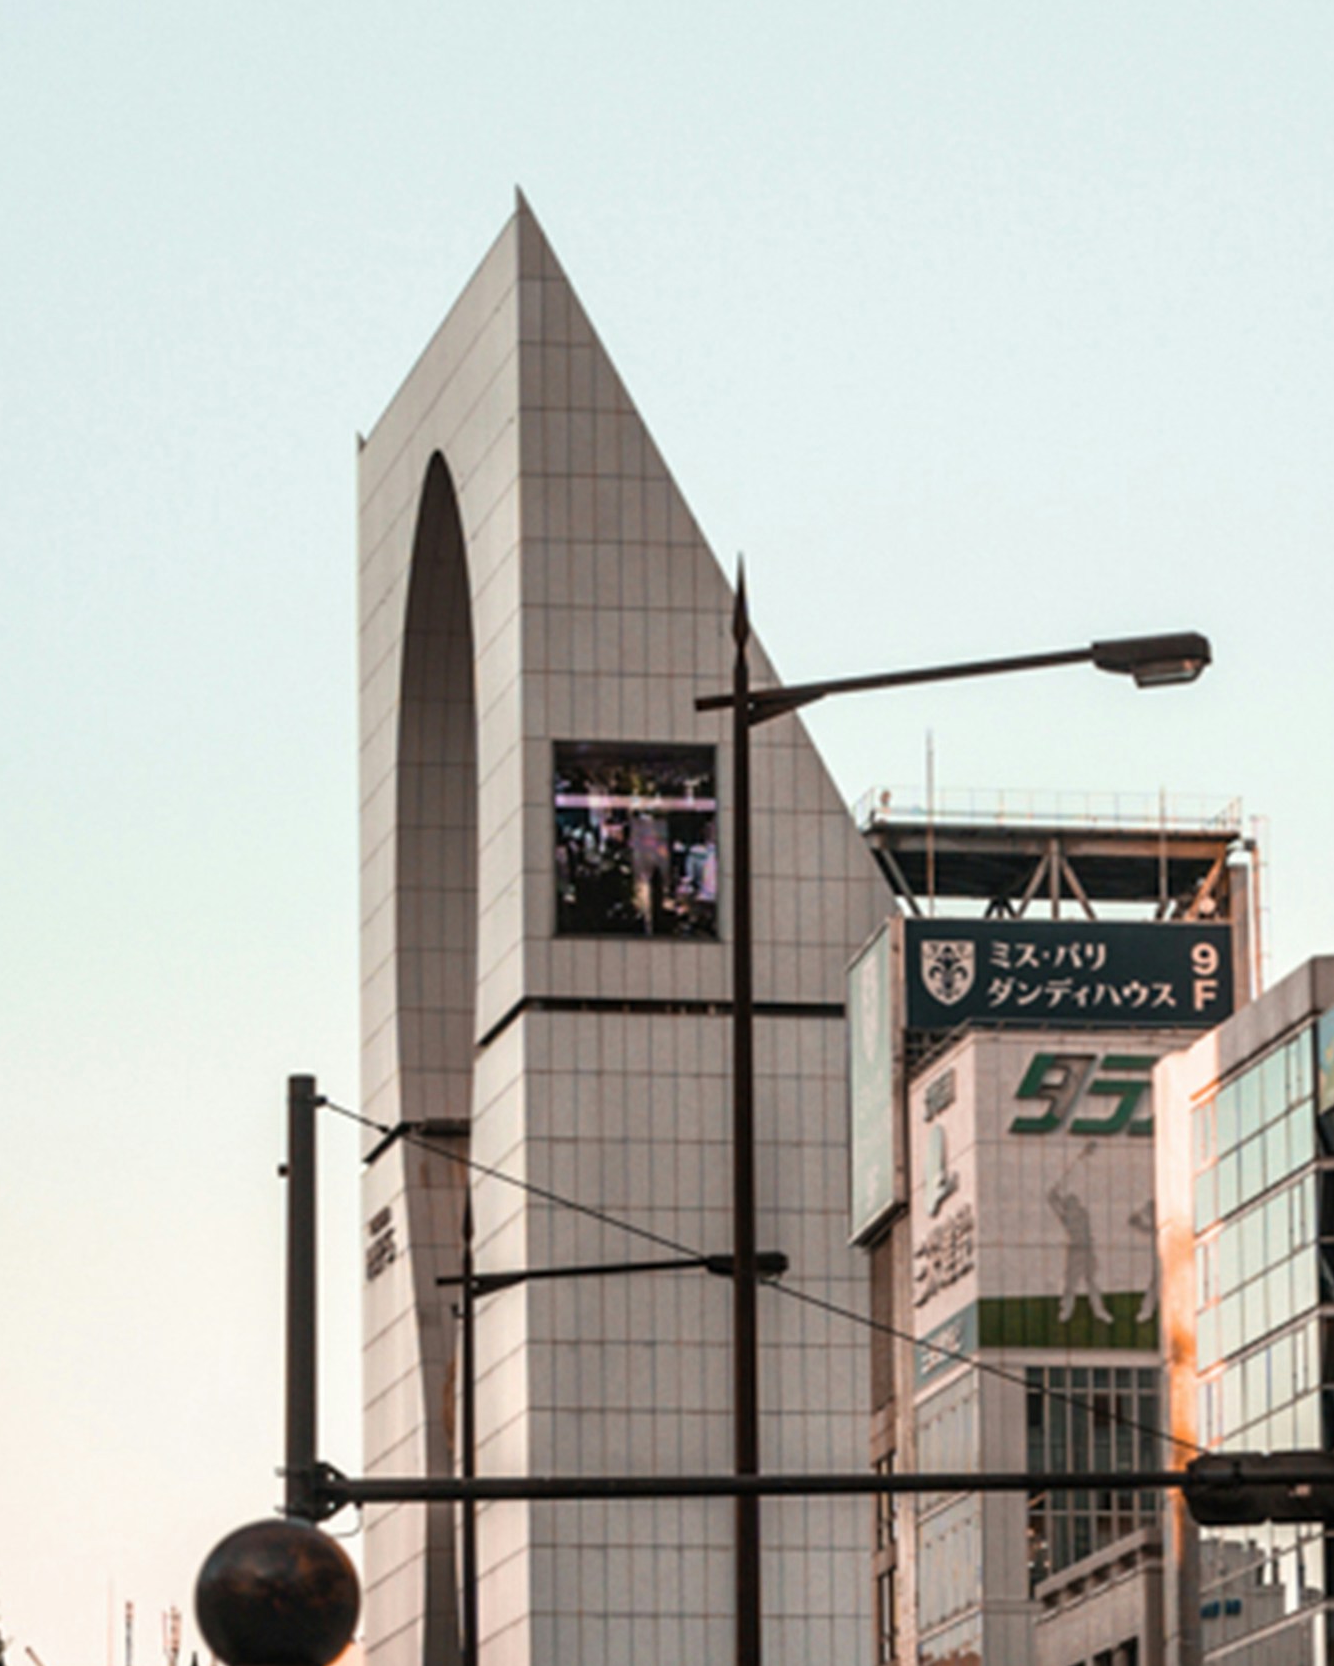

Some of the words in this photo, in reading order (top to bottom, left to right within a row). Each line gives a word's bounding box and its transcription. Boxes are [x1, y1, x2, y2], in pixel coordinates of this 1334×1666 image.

[989, 940, 1107, 971] ミス・パリ
[987, 977, 1177, 1009] ダンディハウス
